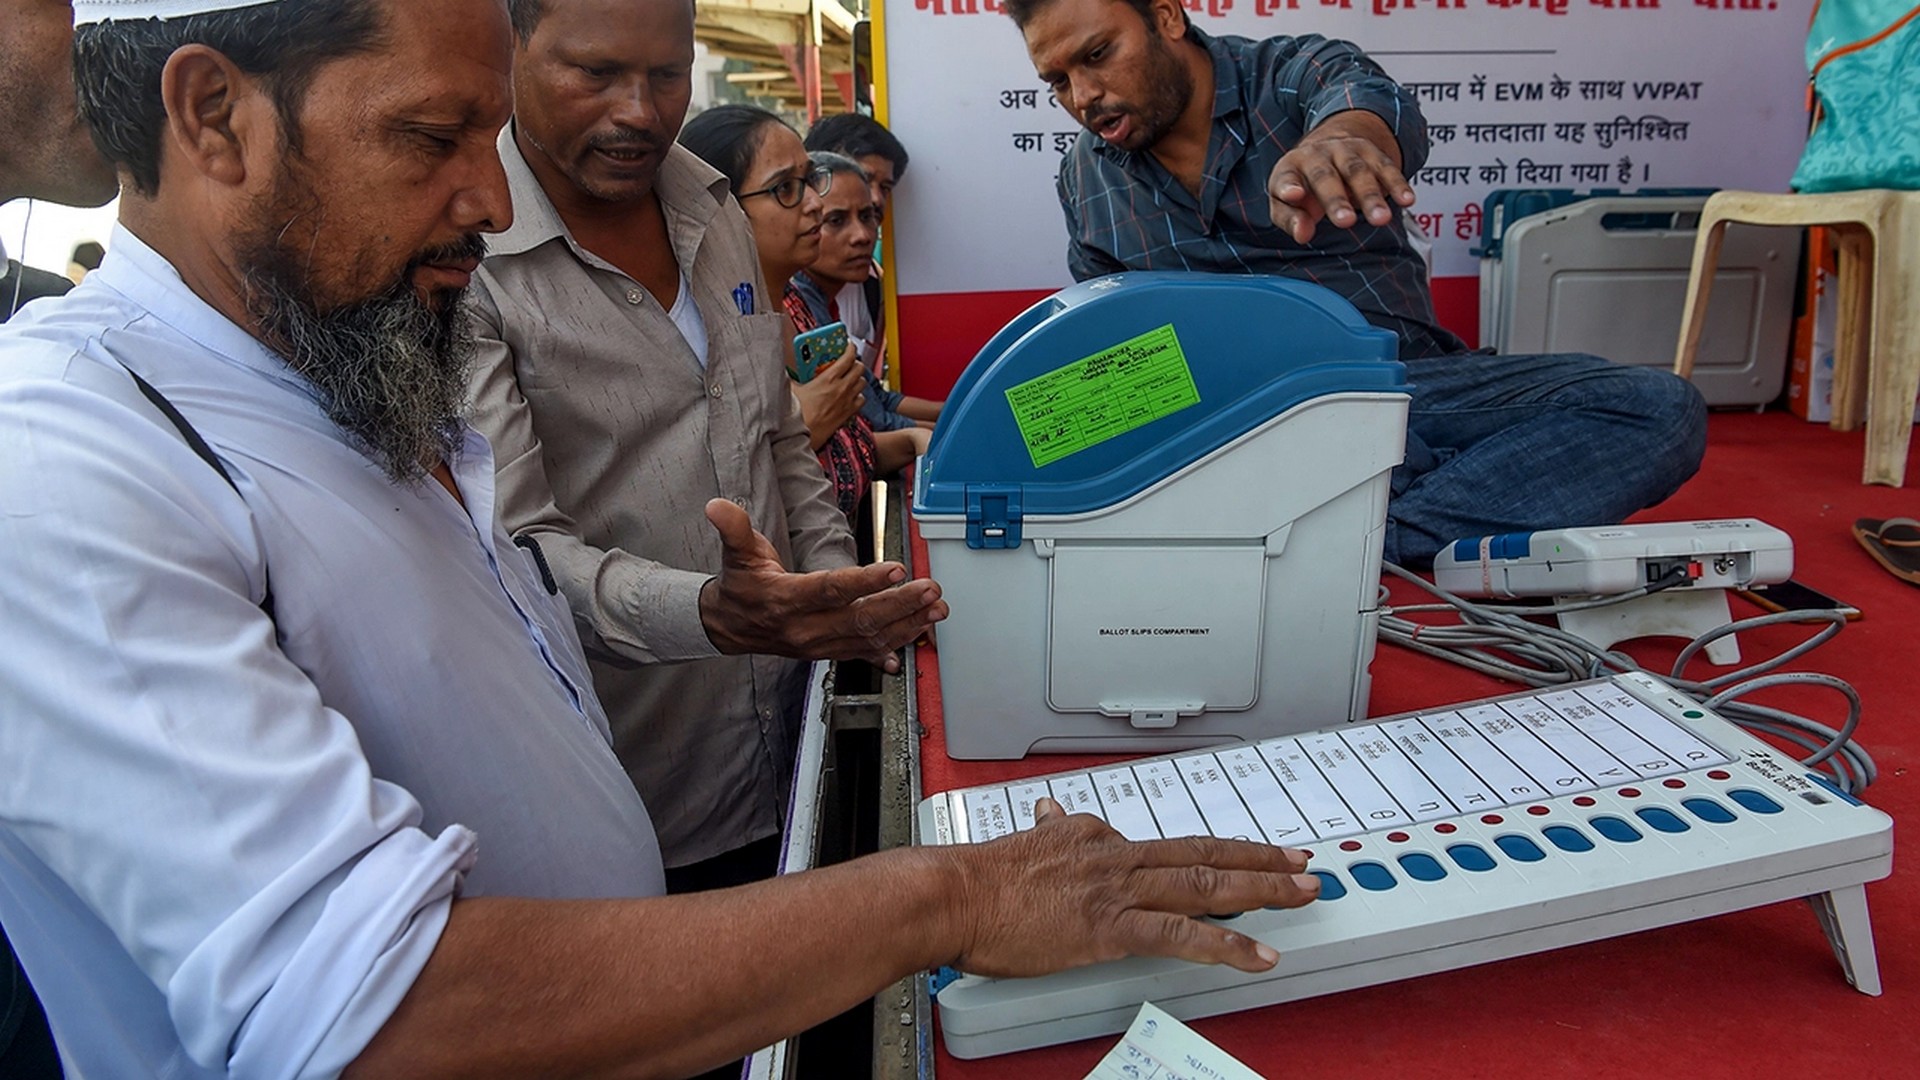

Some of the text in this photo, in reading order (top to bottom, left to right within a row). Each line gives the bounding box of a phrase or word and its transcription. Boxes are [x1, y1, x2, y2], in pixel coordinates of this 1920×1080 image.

[1000, 89, 1038, 109] अब
[1469, 74, 1486, 101] में
[1495, 83, 1543, 101] EVM
[1550, 72, 1572, 100] के
[1579, 80, 1625, 100] साथ
[1632, 82, 1703, 100] VVPAT
[1012, 133, 1044, 152] का
[1464, 123, 1547, 143] मतदाता
[1554, 122, 1587, 144] यह
[1593, 114, 1690, 149] सुनिश्चित
[1478, 157, 1508, 185] को
[1516, 158, 1564, 184] दिया
[1571, 163, 1610, 183] गया
[1617, 155, 1633, 184] है
[1099, 628, 1210, 636] BALLOT SLIPS COMPARTMENT
[1745, 761, 1797, 792] Ballot Unit
